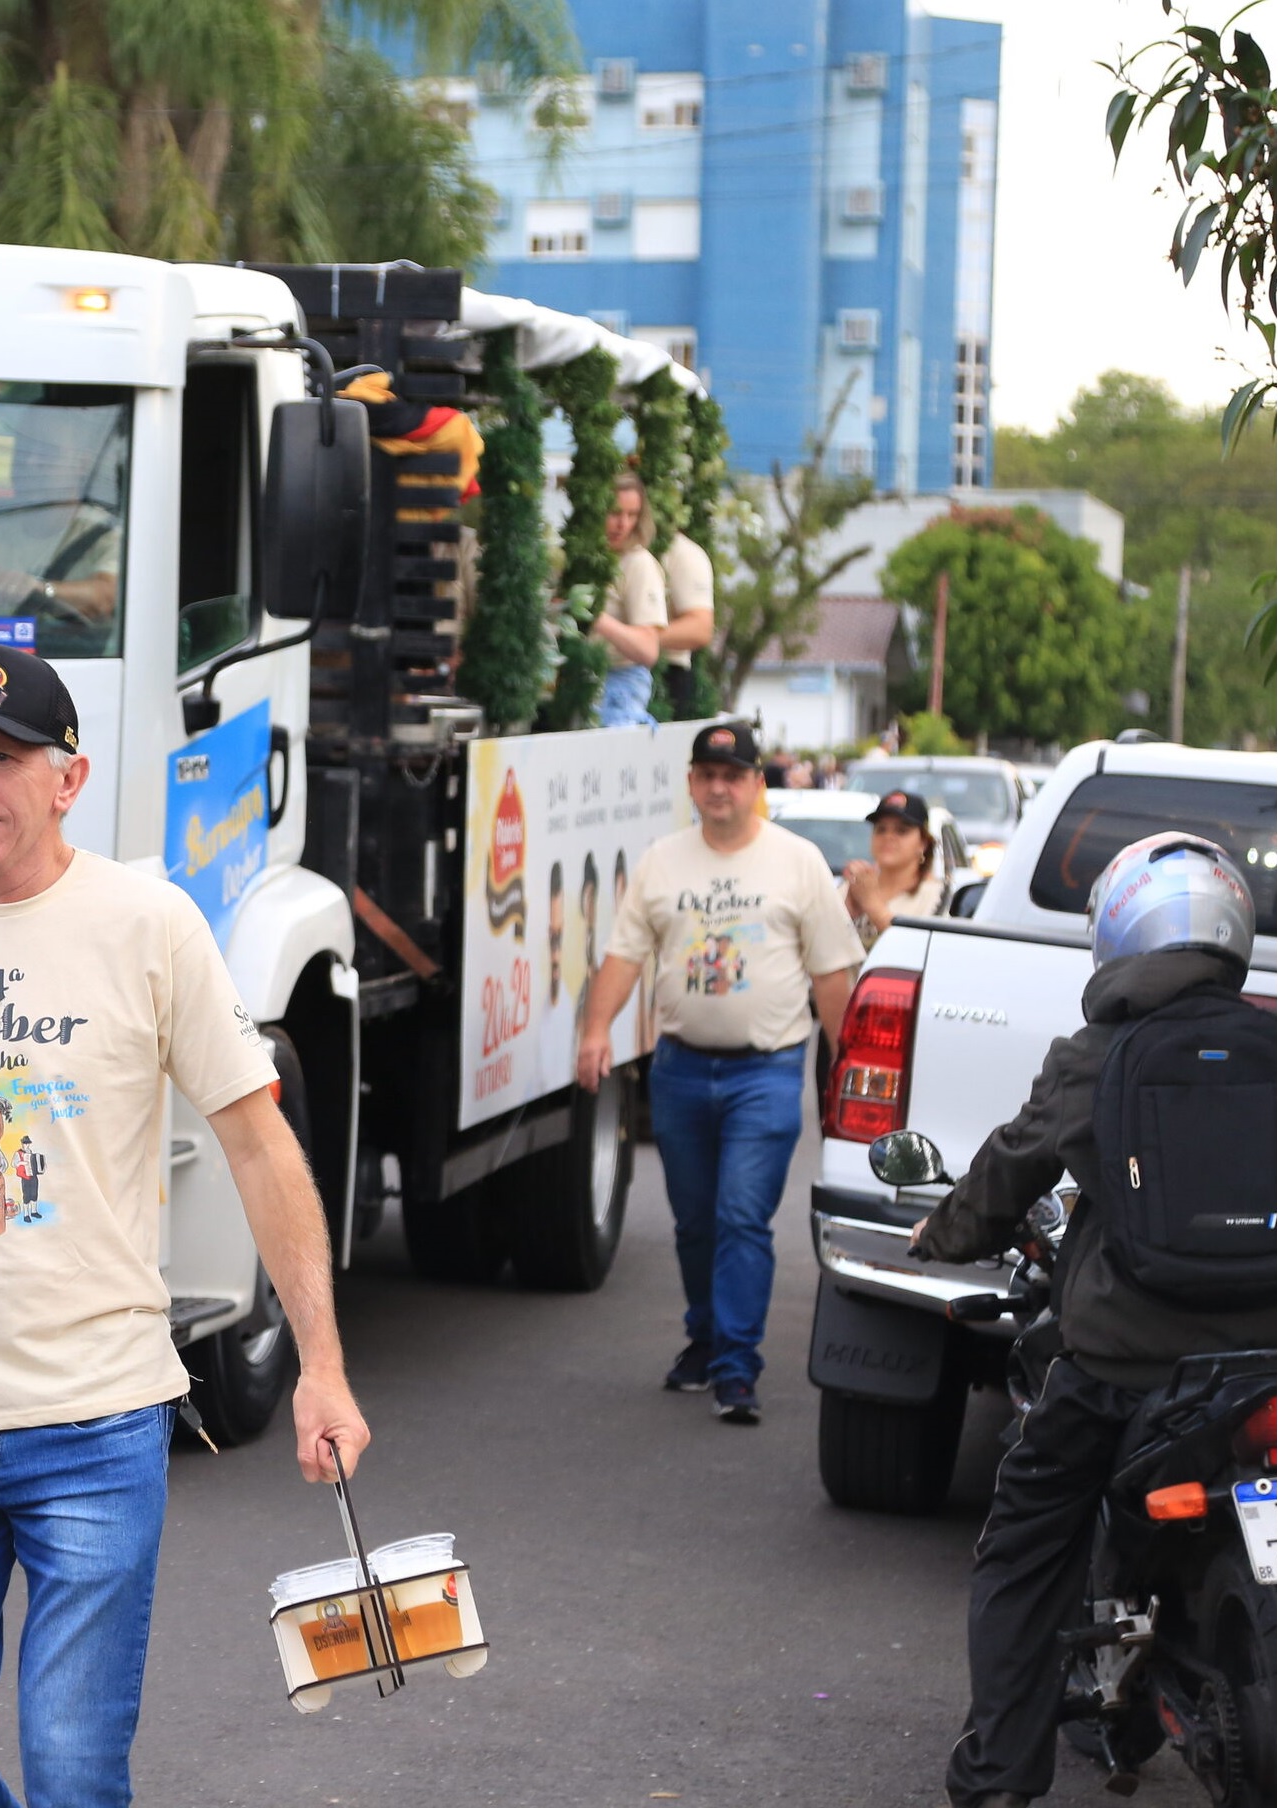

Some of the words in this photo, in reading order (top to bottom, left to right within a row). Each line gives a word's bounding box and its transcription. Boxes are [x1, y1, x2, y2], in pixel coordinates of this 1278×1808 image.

[931, 1002, 1008, 1026] TOYOTA
[10, 1074, 76, 1096] Emoção
[1258, 1566, 1274, 1579] BR
